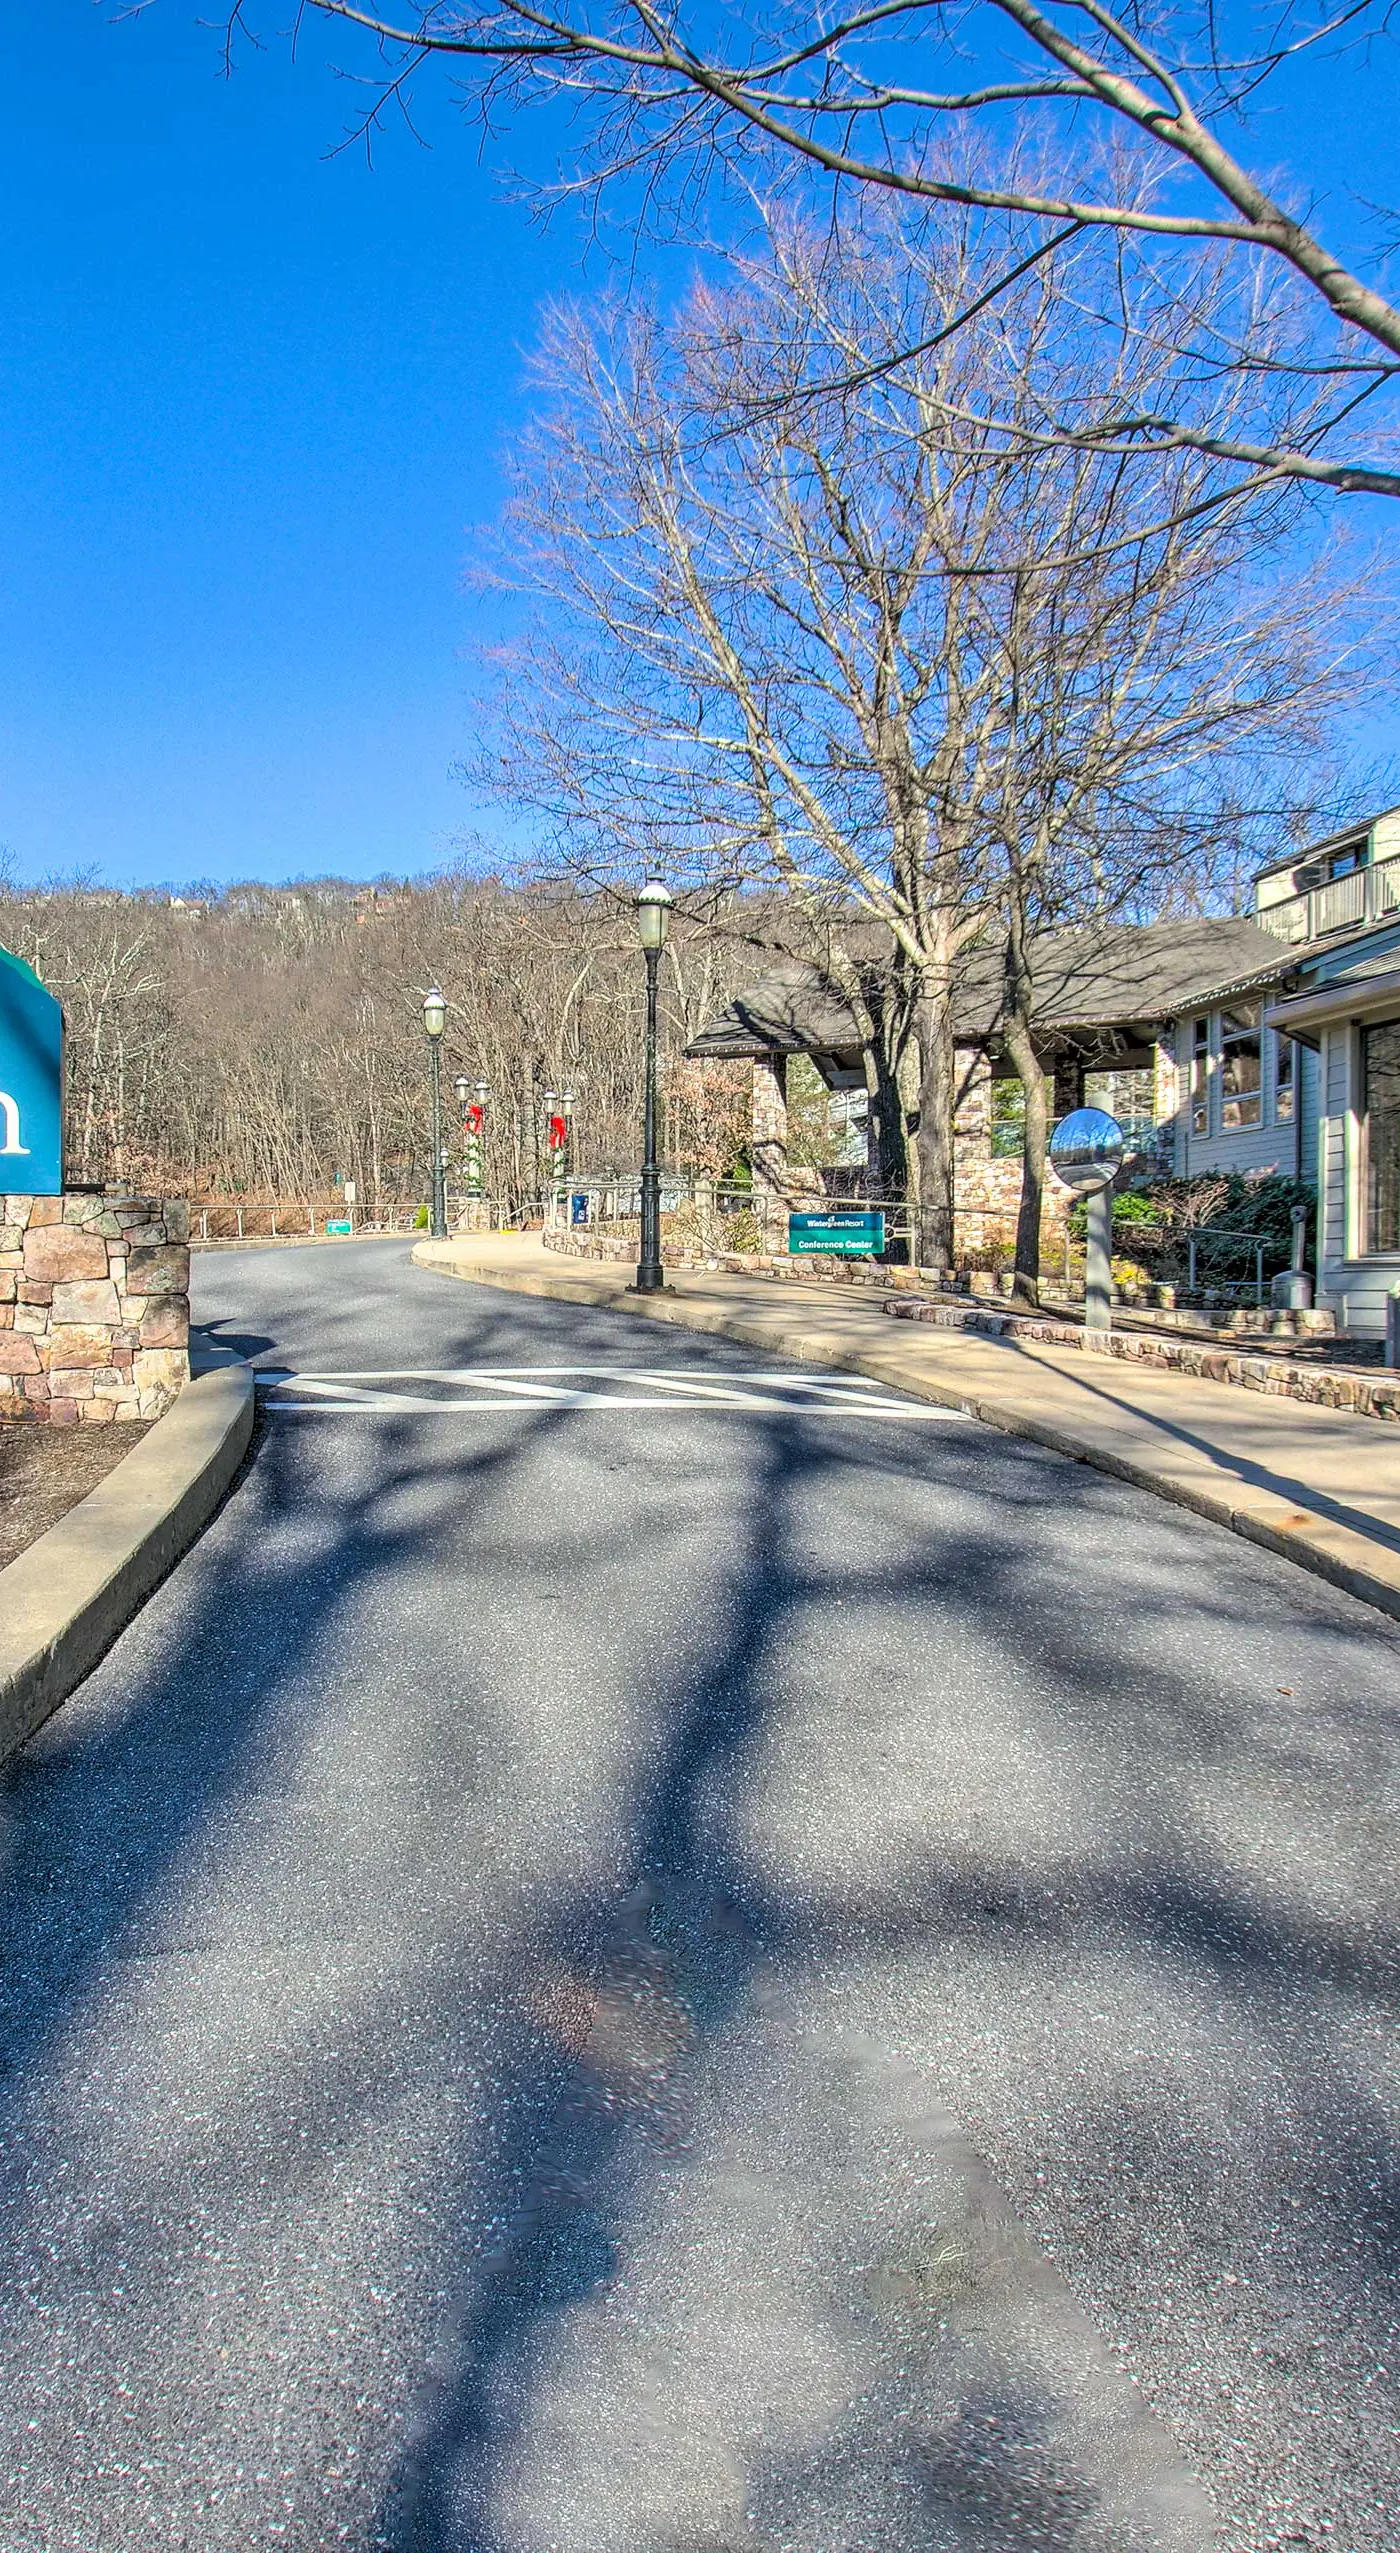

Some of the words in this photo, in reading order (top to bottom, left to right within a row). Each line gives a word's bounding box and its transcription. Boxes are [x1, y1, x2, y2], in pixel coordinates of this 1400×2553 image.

[807, 1219, 845, 1228] Wintergreen
[798, 1240, 844, 1249] Conference
[845, 1240, 873, 1249] Center
